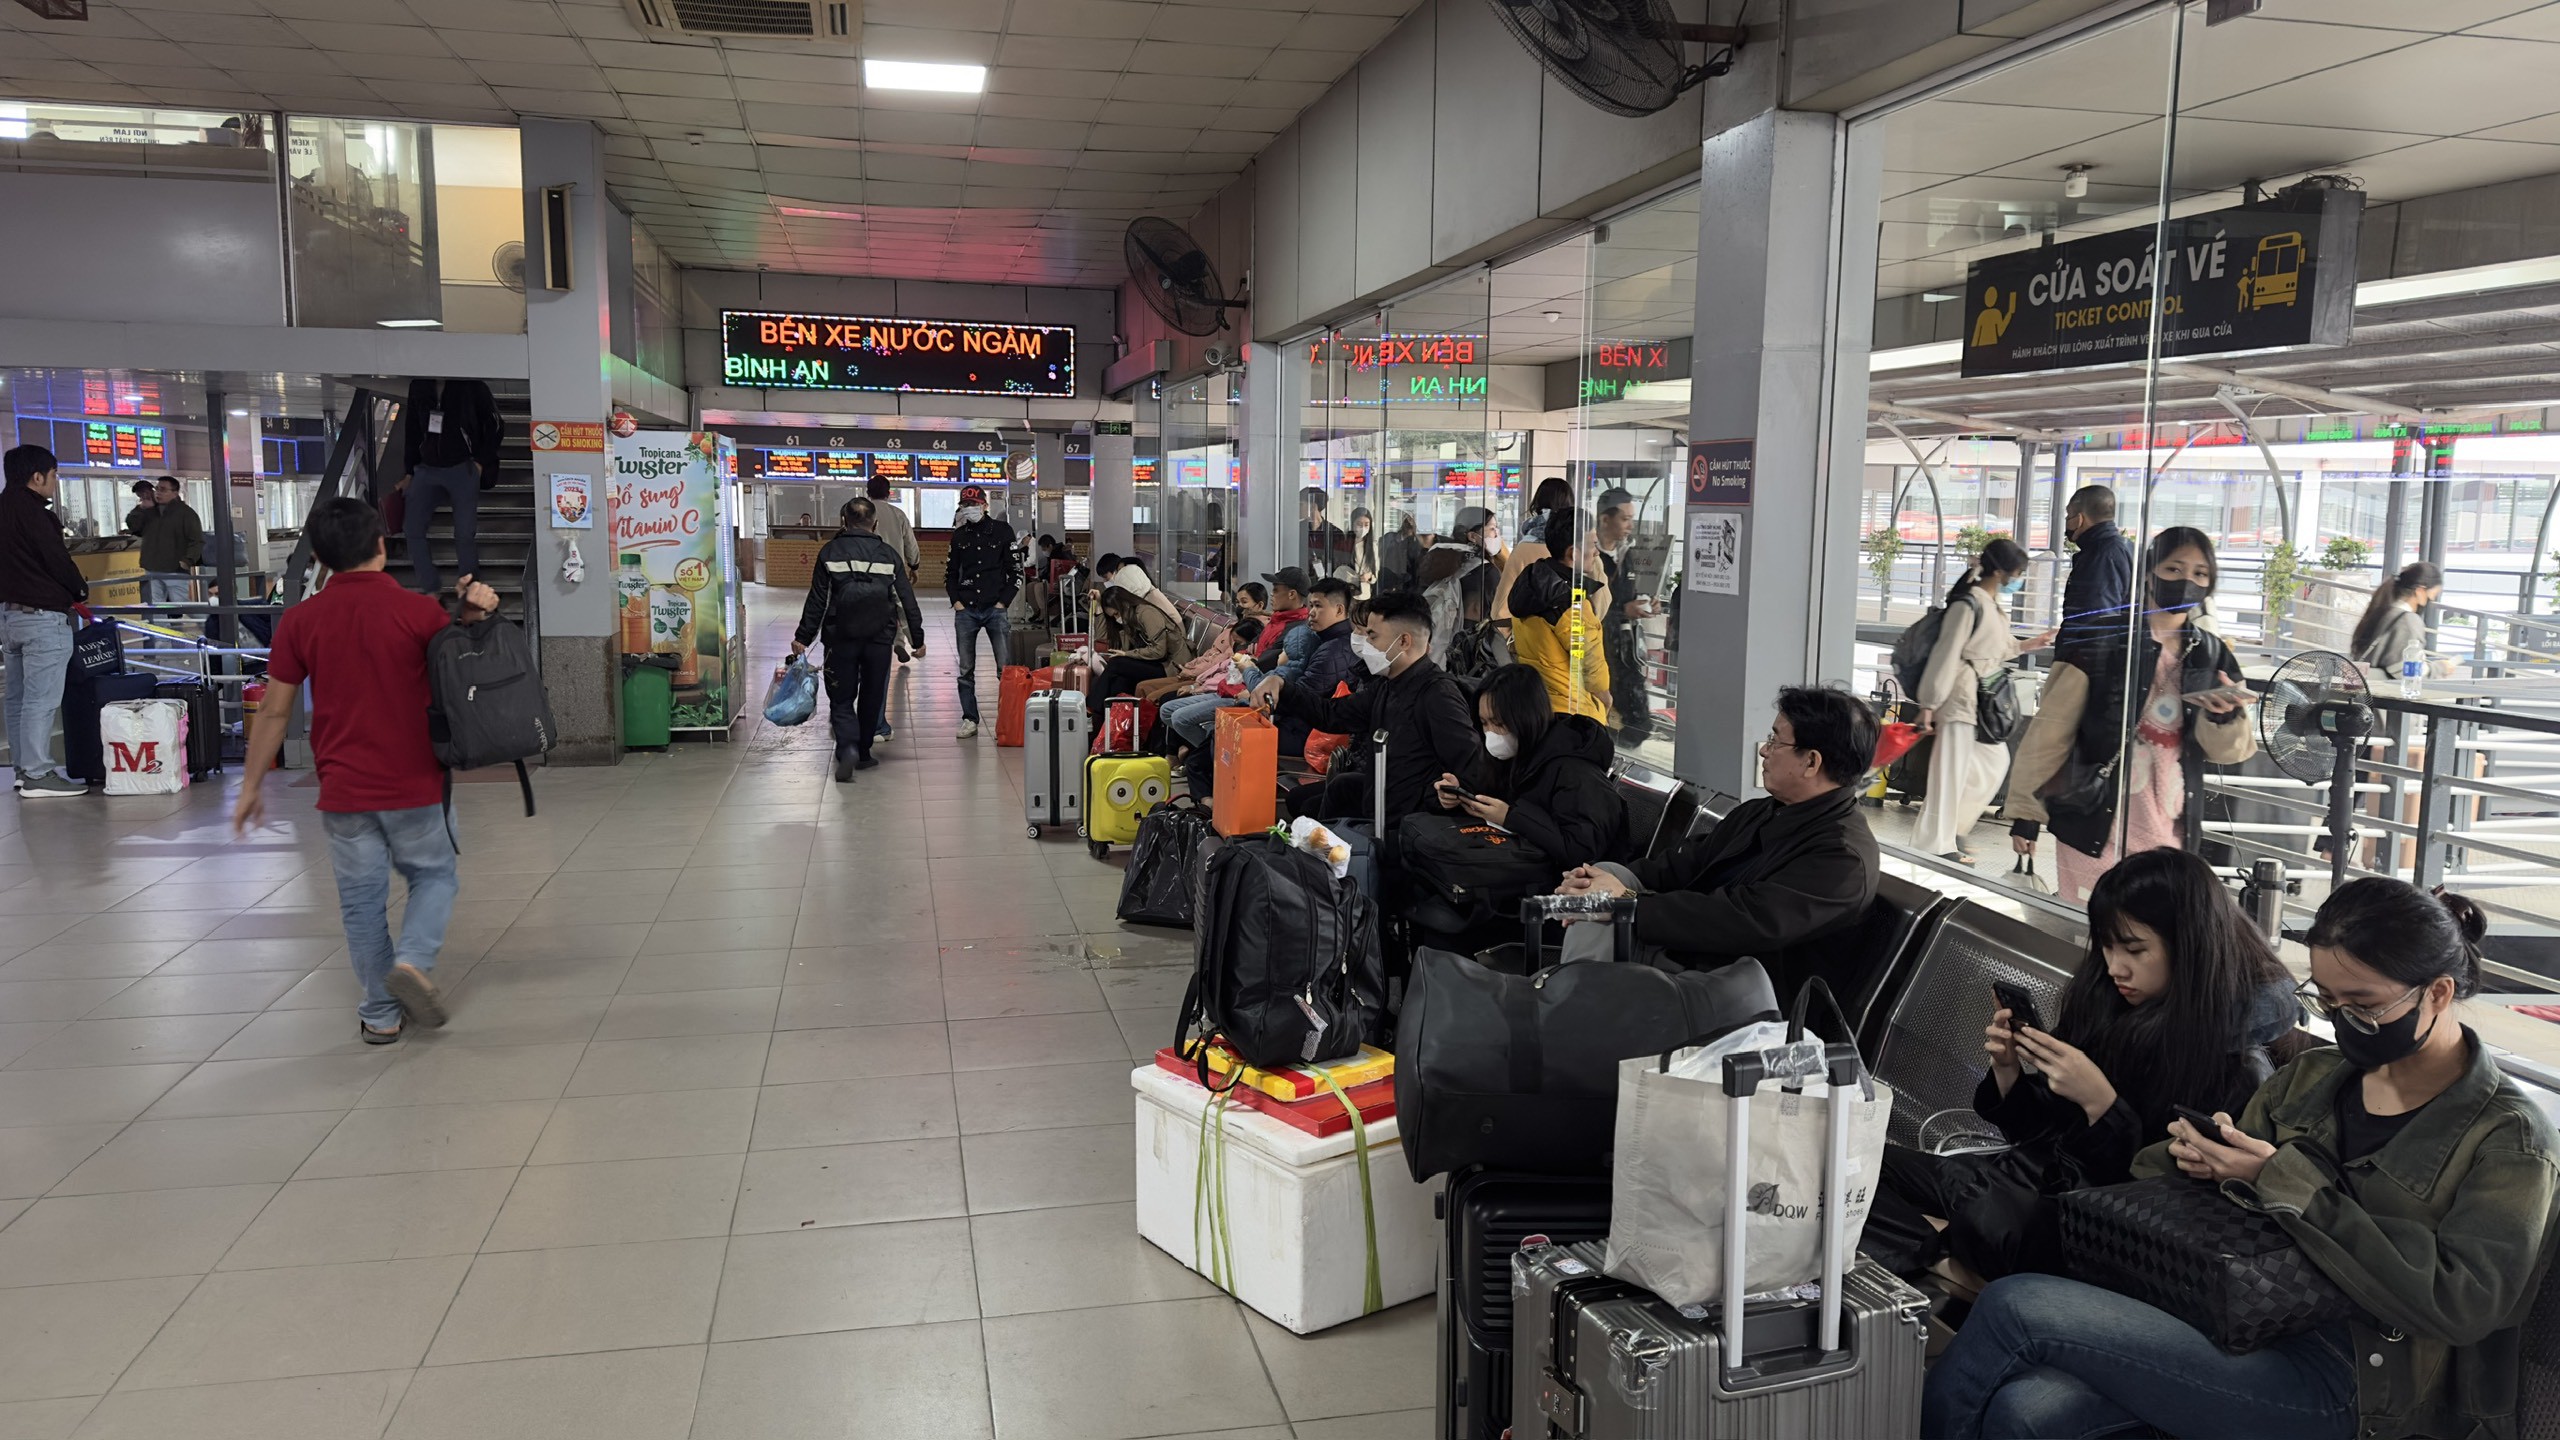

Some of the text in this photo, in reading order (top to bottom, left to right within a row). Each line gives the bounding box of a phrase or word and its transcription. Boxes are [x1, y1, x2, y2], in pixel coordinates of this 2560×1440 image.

[2028, 229, 2227, 306] CỬA SOÁT VÉ
[2055, 295, 2184, 330] TICKET CONTOL
[761, 316, 1042, 355] BẾN XE NƯỚC NGẦM
[2032, 342, 2058, 356] KHÁCH
[2059, 343, 2072, 355] VUI
[2162, 331, 2174, 342] XE
[2175, 328, 2190, 340] KHI
[2191, 326, 2210, 339] QUA
[2213, 320, 2233, 336] CỬA
[726, 353, 829, 381] BÌNH AN
[561, 439, 603, 448] NO SMOKING
[786, 435, 800, 446] 61
[829, 437, 845, 447] 62
[886, 438, 902, 449] 63
[932, 439, 948, 450] 64
[977, 441, 993, 451] 65
[639, 447, 681, 459] Tropicana
[1066, 443, 1080, 453] 67
[1709, 457, 1751, 470] CẤM HÚT THUỐC
[1712, 475, 1746, 489] No Smoking
[640, 481, 684, 509] sung
[682, 509, 699, 534] C
[651, 605, 691, 619] Twister
[1773, 1203, 1808, 1219] DQW
